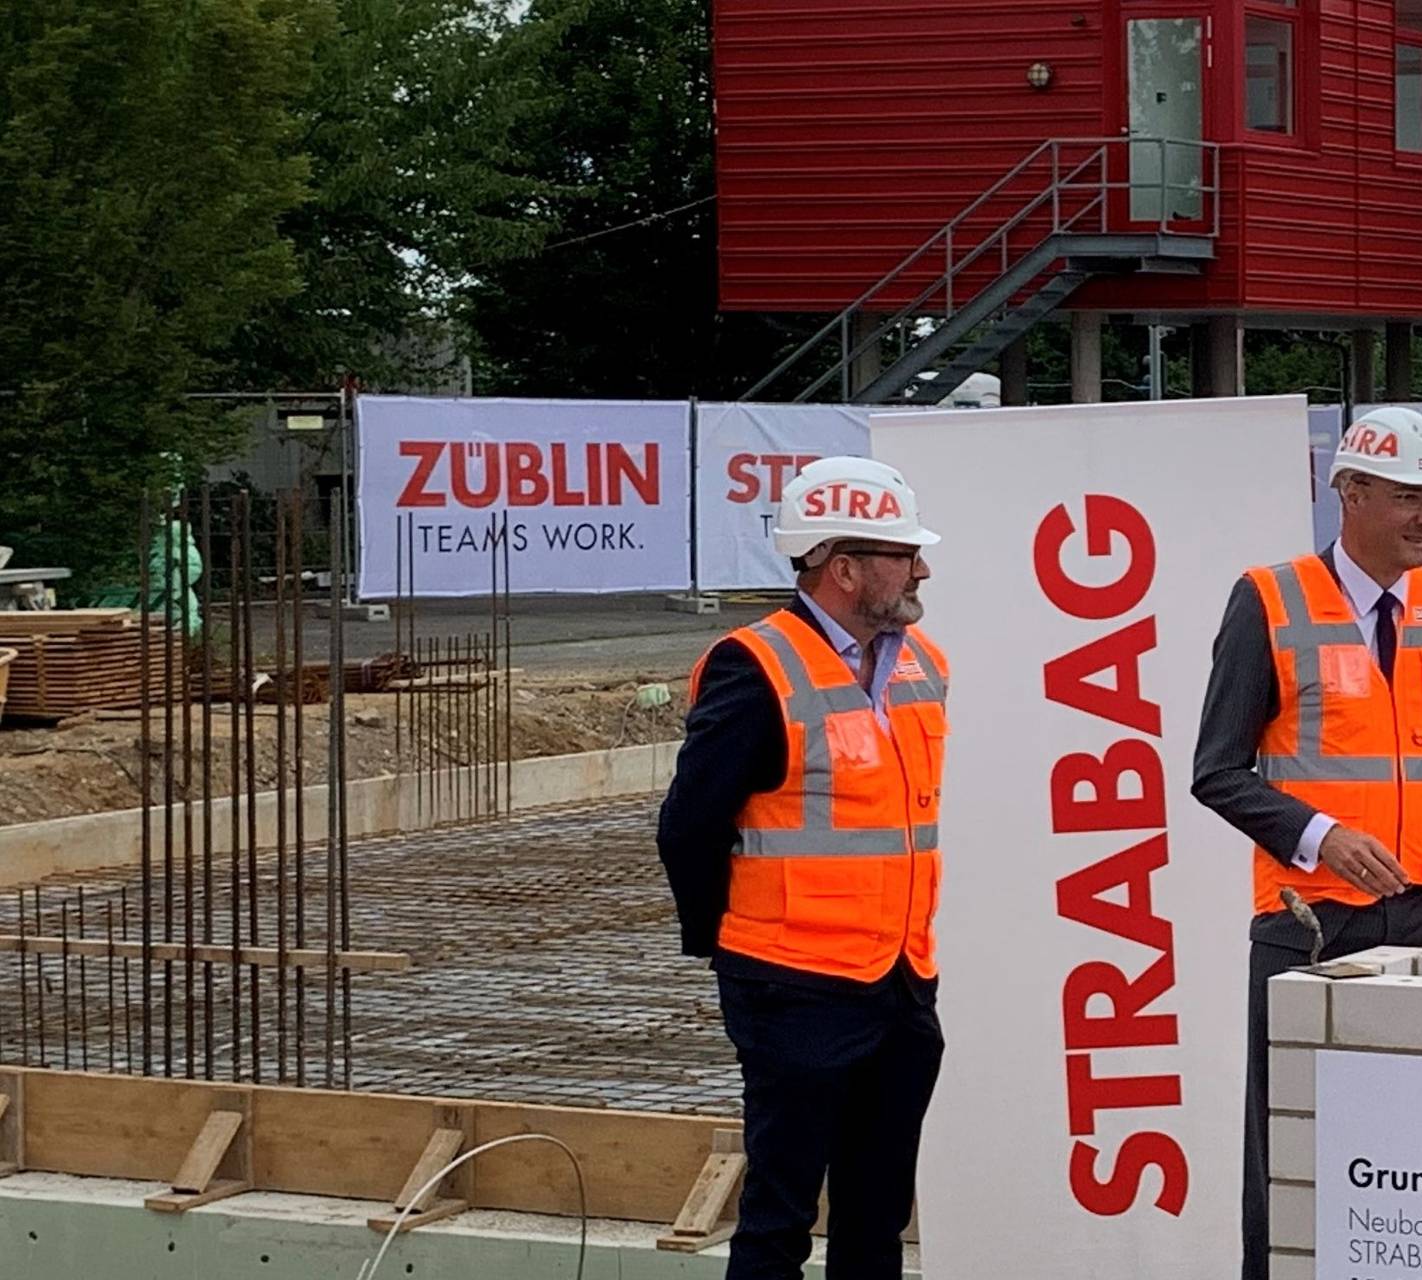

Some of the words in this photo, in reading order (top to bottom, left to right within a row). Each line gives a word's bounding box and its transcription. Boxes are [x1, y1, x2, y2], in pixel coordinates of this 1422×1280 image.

[395, 441, 660, 508] ZÜBLIN
[804, 483, 903, 519] STRA
[418, 524, 528, 554] TEAMS
[1033, 493, 1190, 1218] STRABAG
